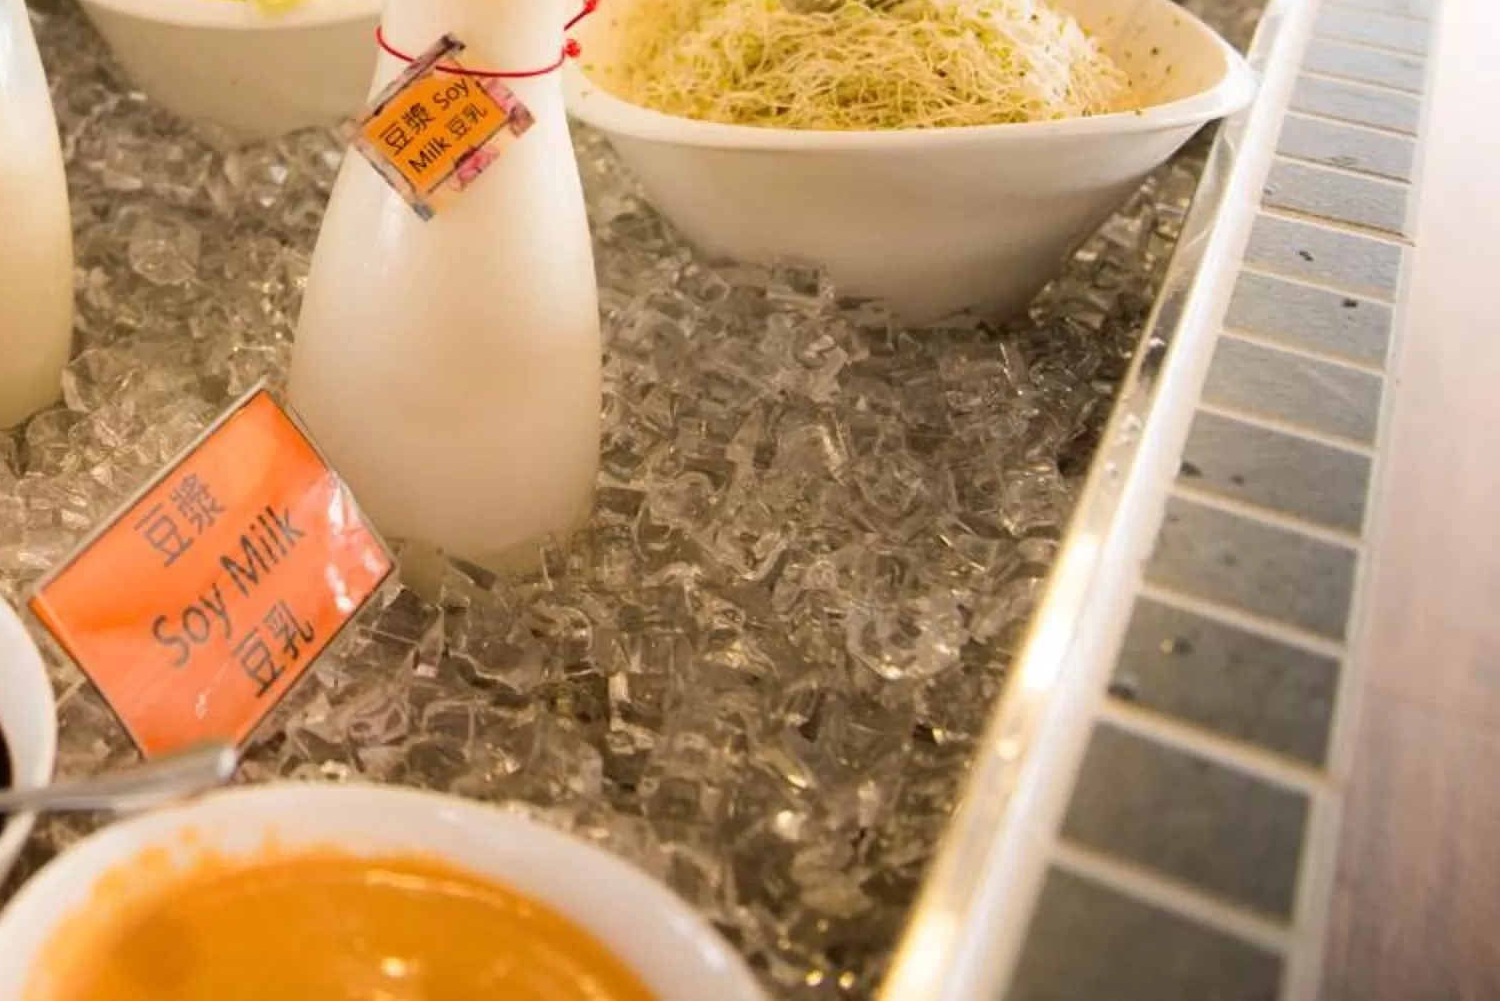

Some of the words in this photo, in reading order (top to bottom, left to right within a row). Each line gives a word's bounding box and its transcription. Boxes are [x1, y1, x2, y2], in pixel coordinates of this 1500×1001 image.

[432, 78, 469, 111] Soy
[408, 136, 451, 173] Milk
[134, 473, 227, 568] 豆漿
[153, 582, 234, 668] Soy
[219, 505, 305, 599] Milk
[232, 599, 315, 698] 豆乳
